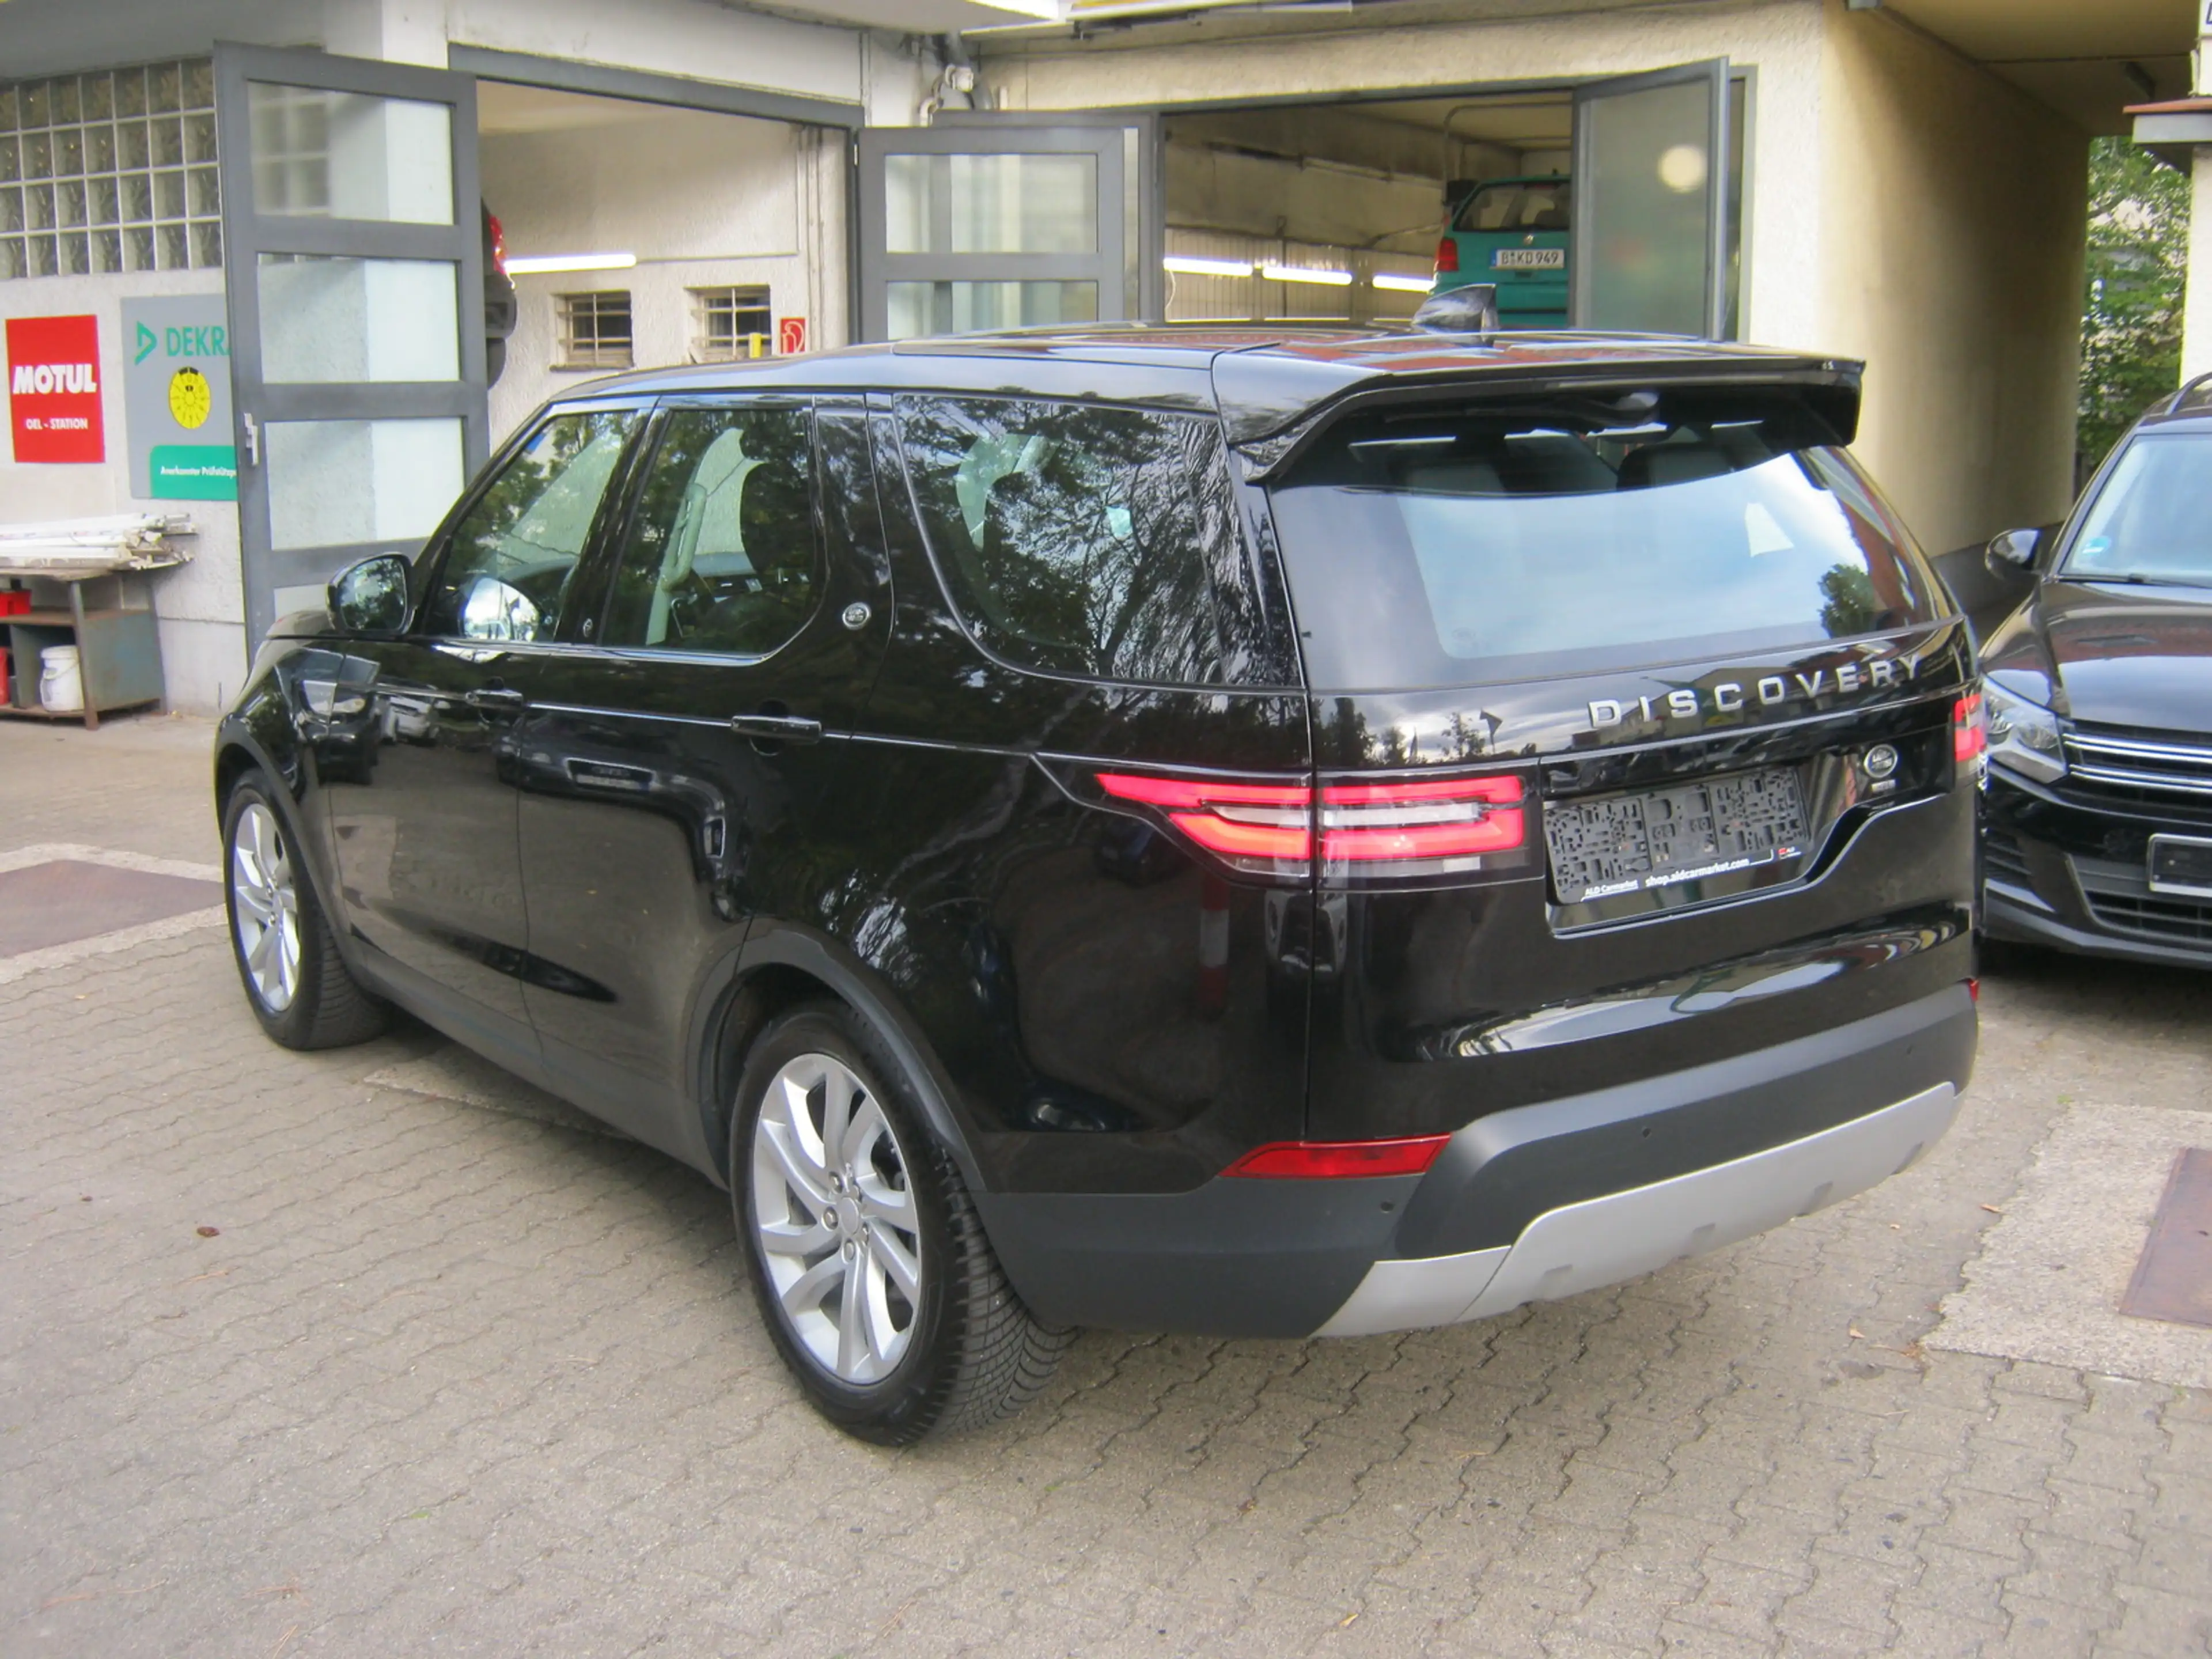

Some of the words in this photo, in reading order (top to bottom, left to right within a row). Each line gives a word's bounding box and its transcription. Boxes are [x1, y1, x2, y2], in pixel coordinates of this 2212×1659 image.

[1501, 251, 1509, 264] B
[1536, 251, 1559, 264] 949
[166, 326, 231, 356] DEKR
[13, 363, 97, 394] MOTUL
[25, 418, 43, 430] OEL
[50, 418, 88, 430] STATION
[1588, 655, 1921, 729] DISCOVERY
[1645, 858, 1750, 888] shop.aldcarmarket.com
